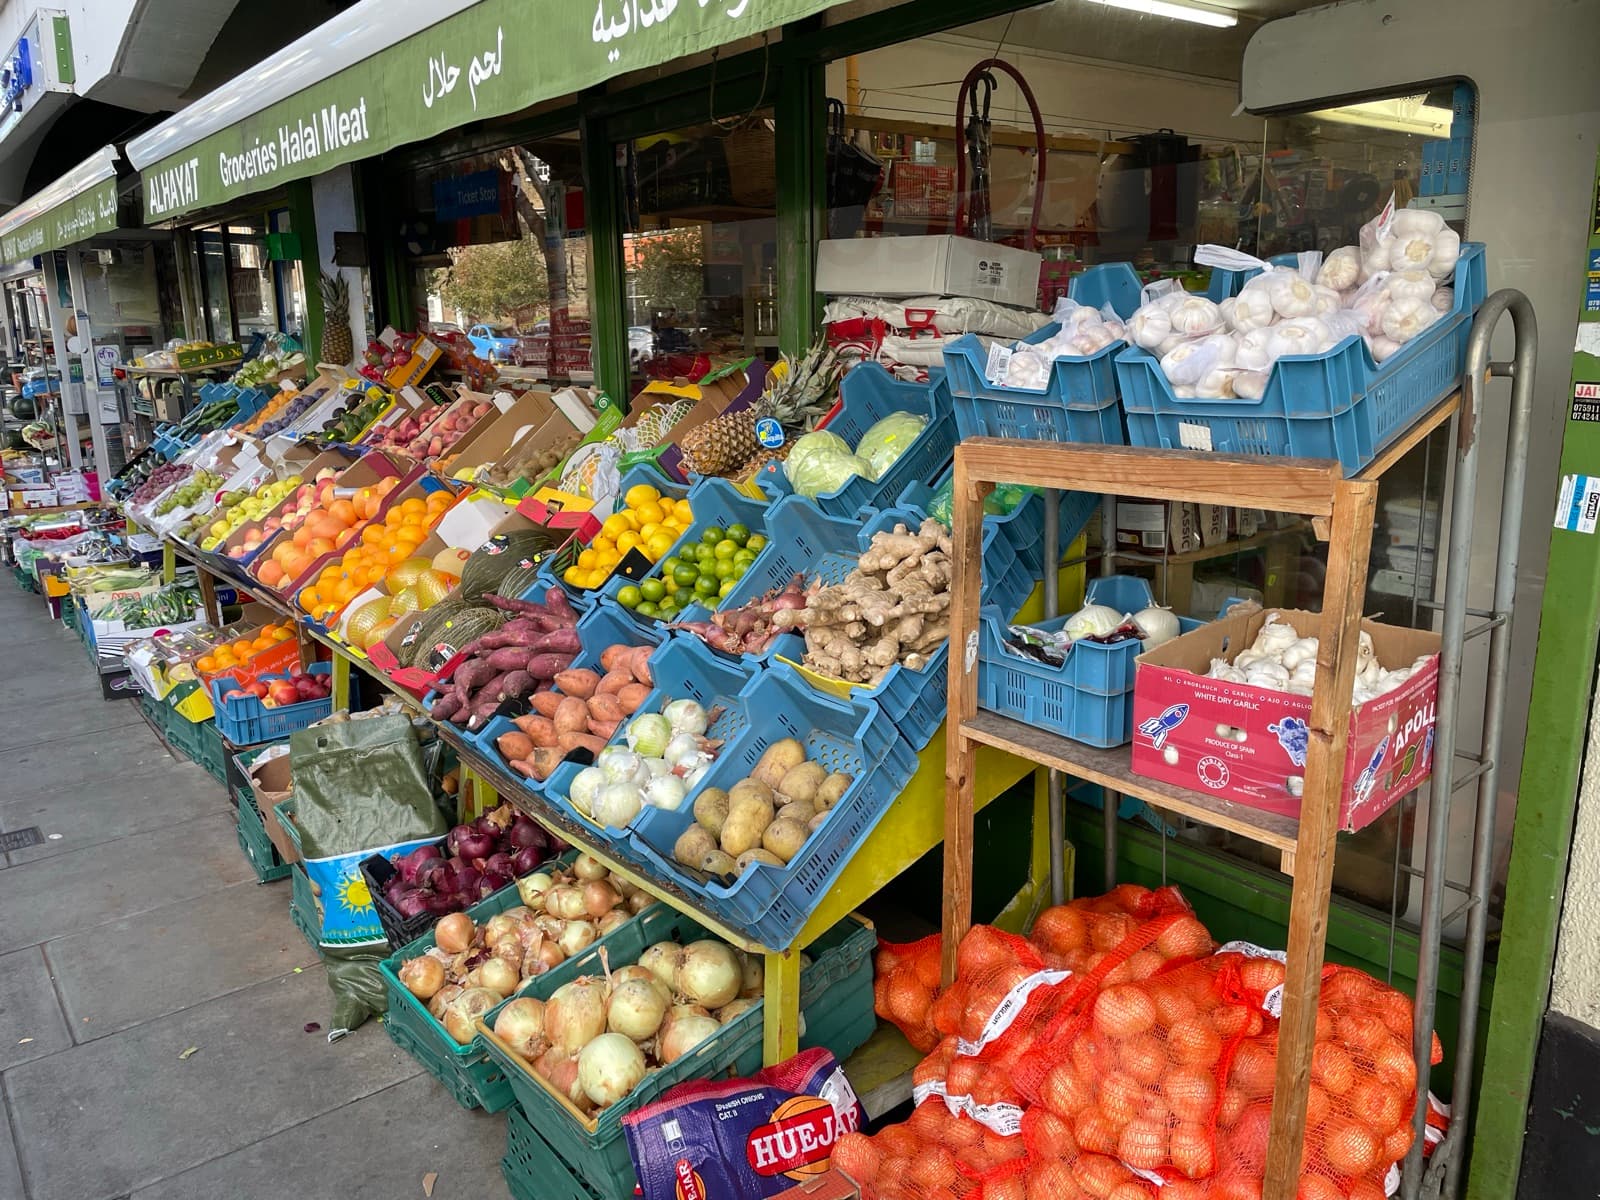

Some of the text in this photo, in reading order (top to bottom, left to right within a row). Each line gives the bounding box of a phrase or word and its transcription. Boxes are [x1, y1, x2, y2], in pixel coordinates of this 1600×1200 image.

[422, 25, 503, 113] لحم حلال
[219, 96, 370, 188] Groceries Halal Meat
[149, 157, 199, 215] ALHAYAT
[1194, 690, 1260, 712] WHITE DRY GARLIC
[1231, 690, 1254, 700] GARLIC
[1268, 697, 1280, 705] AJO
[1204, 737, 1230, 750] PRODUCE
[1239, 744, 1256, 755] SPAIN
[715, 1092, 765, 1112] SPANISH ONIONS
[751, 1106, 857, 1168] HUEJAR
